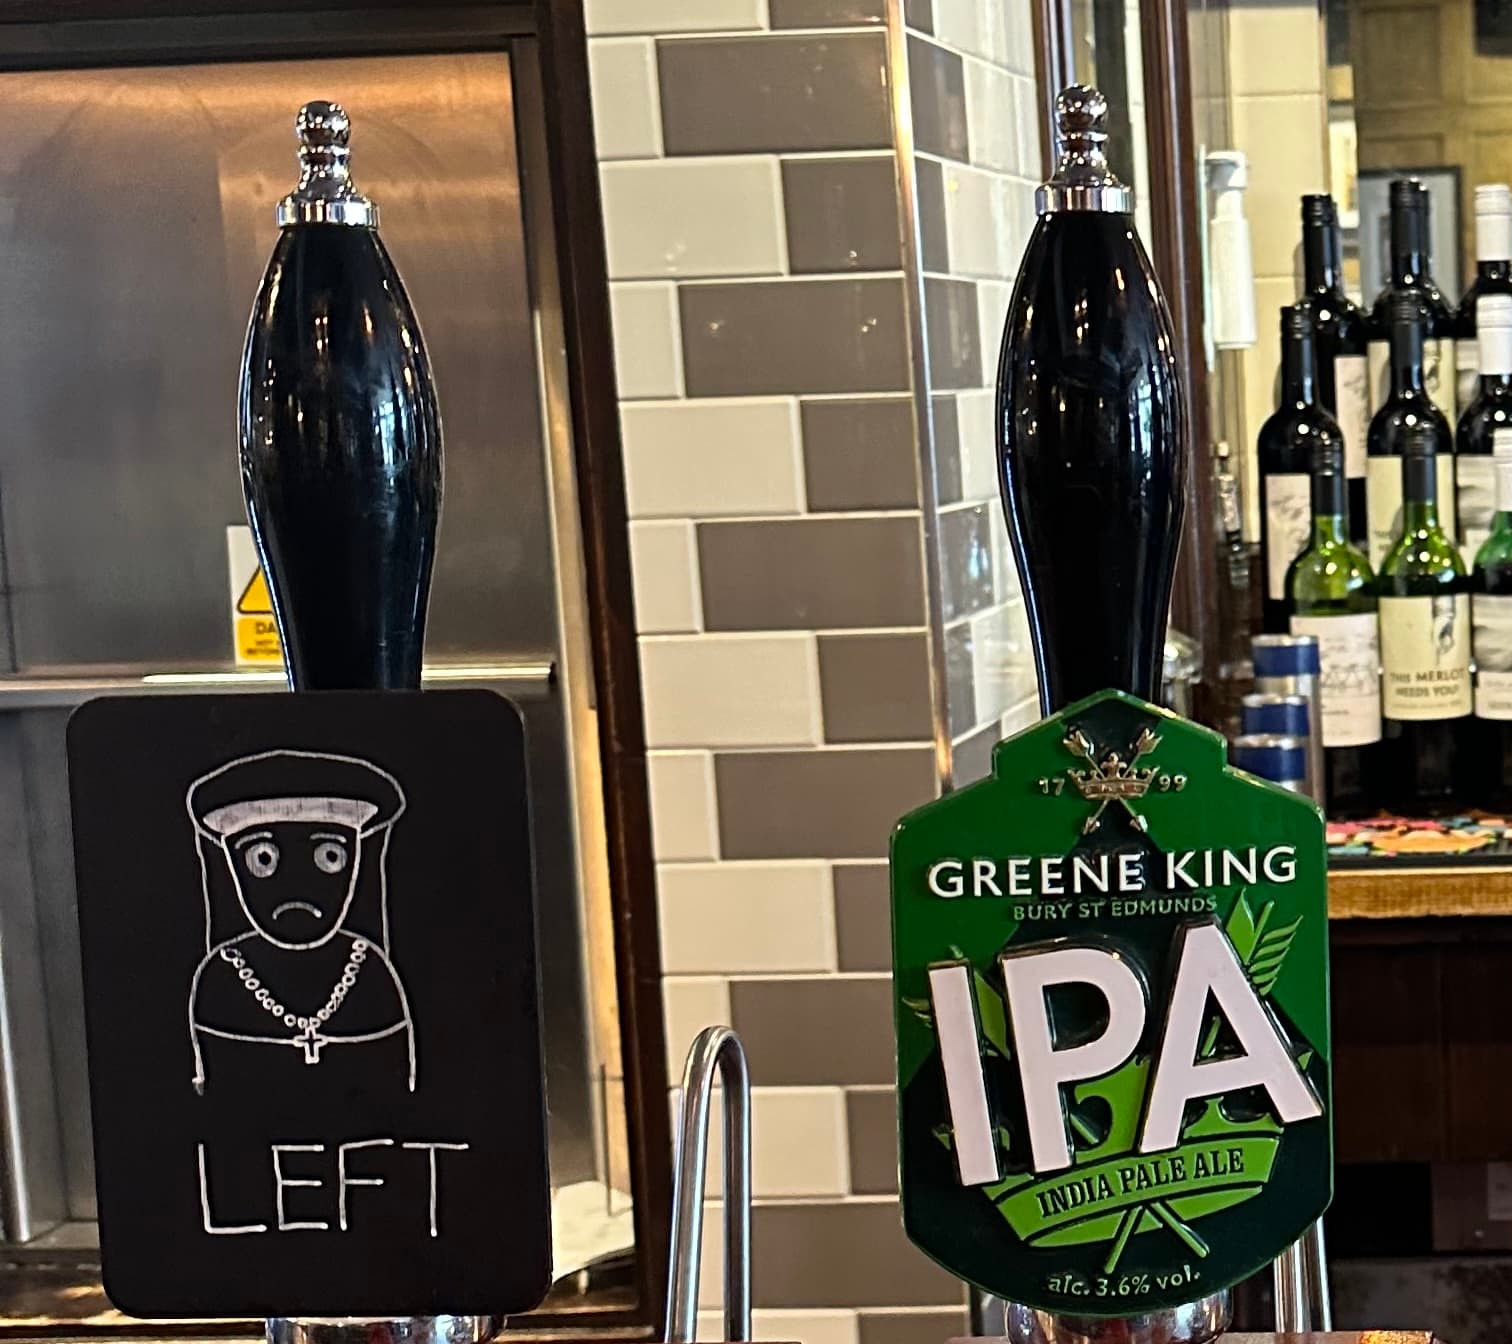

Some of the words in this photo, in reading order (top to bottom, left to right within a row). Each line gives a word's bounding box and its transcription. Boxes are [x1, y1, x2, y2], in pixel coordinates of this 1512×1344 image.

[1416, 668, 1466, 683] MERLOT
[1038, 777, 1065, 797] 17
[1158, 774, 1187, 793] 99
[927, 850, 1147, 899] GREENE
[1165, 845, 1298, 891] KING
[1013, 901, 1072, 922] BURY
[1078, 899, 1106, 918] ST
[1110, 894, 1219, 918] EDMUNDS
[928, 923, 1323, 1187] IPA
[198, 1138, 470, 1238] LEFT
[1036, 1173, 1116, 1218] INDIA
[1117, 1156, 1187, 1194] PALE
[1193, 1147, 1244, 1180] ALE
[1048, 1274, 1090, 1296] alc.
[1095, 1273, 1151, 1297] 3.6%
[1156, 1264, 1201, 1290] vol.
